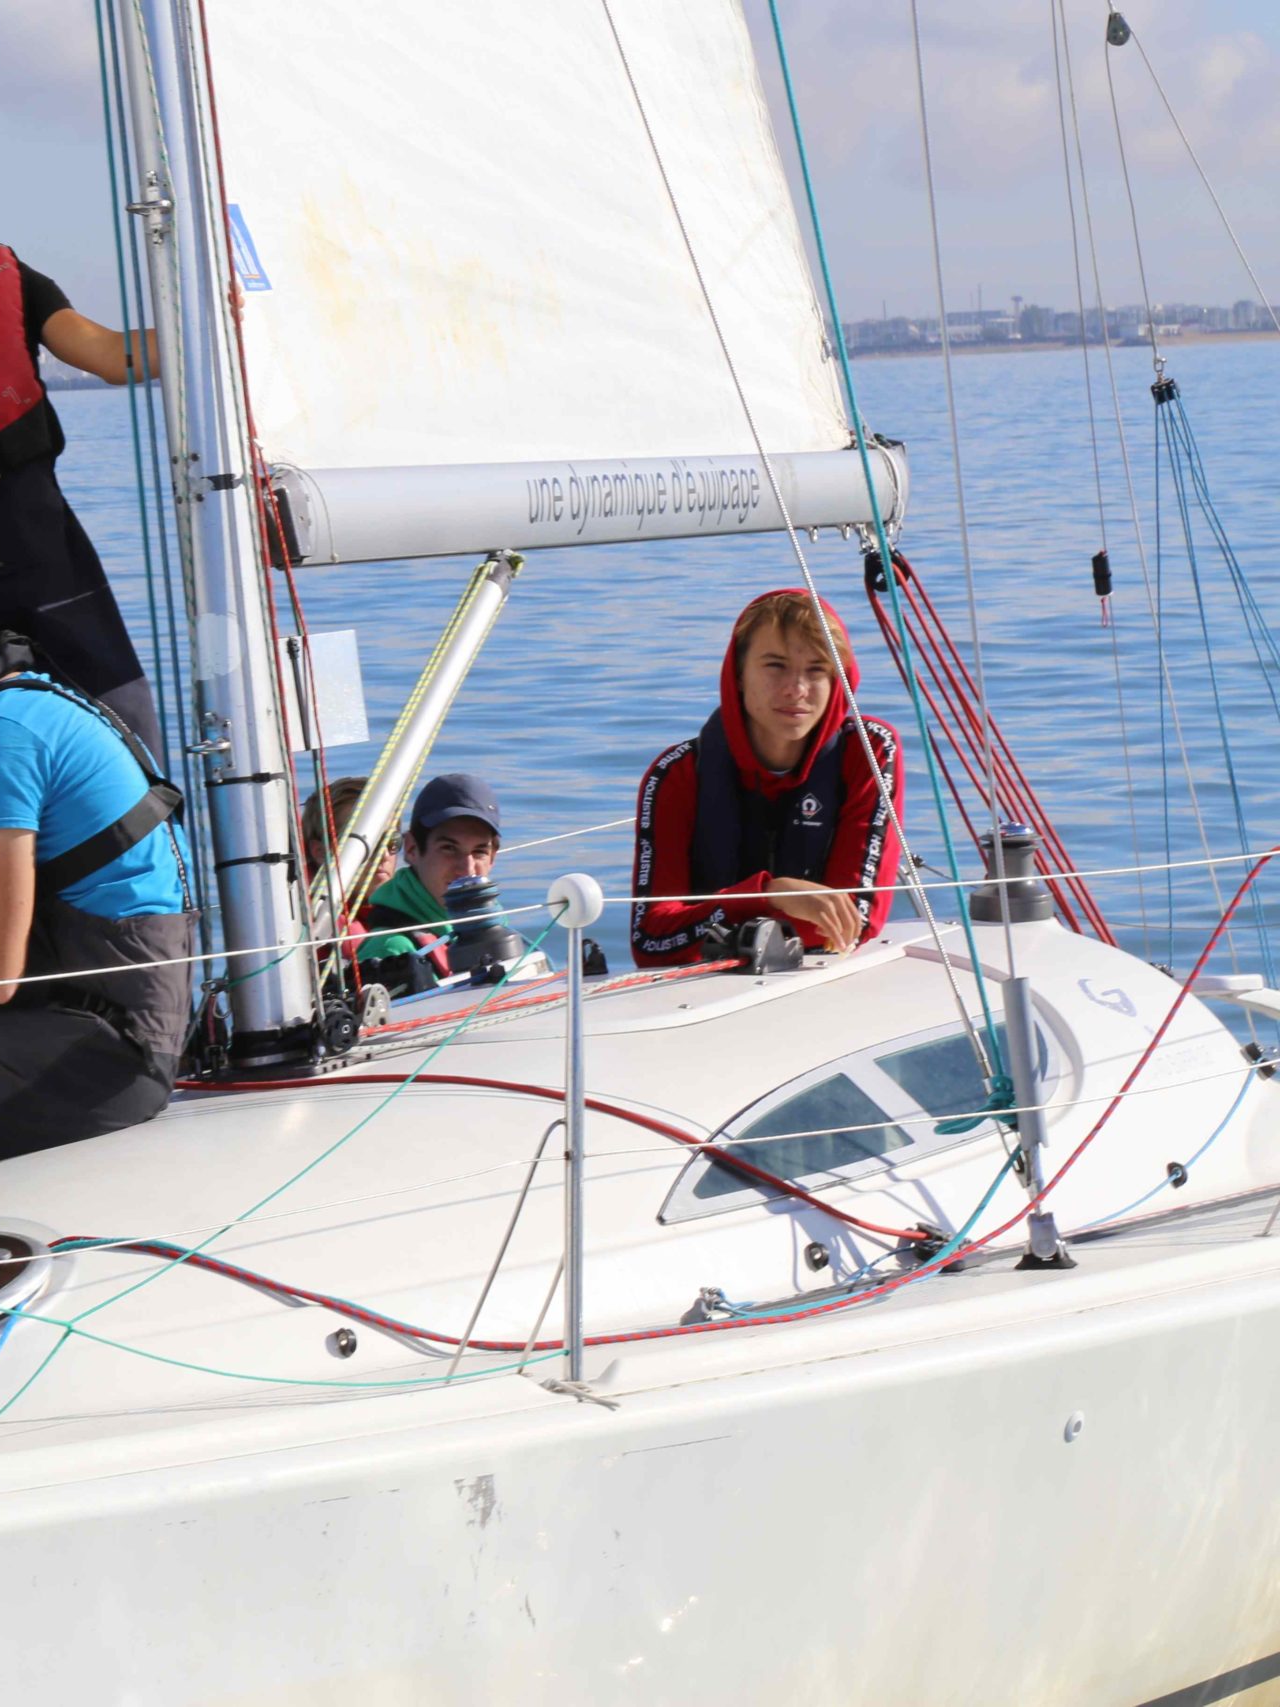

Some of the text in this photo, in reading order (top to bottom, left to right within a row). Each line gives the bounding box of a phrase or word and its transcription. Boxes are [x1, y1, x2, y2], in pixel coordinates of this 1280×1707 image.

[527, 477, 564, 524] une
[567, 461, 667, 535] dynamique
[641, 775, 660, 829] HOLLISTER
[862, 834, 883, 889] HOLLISTER
